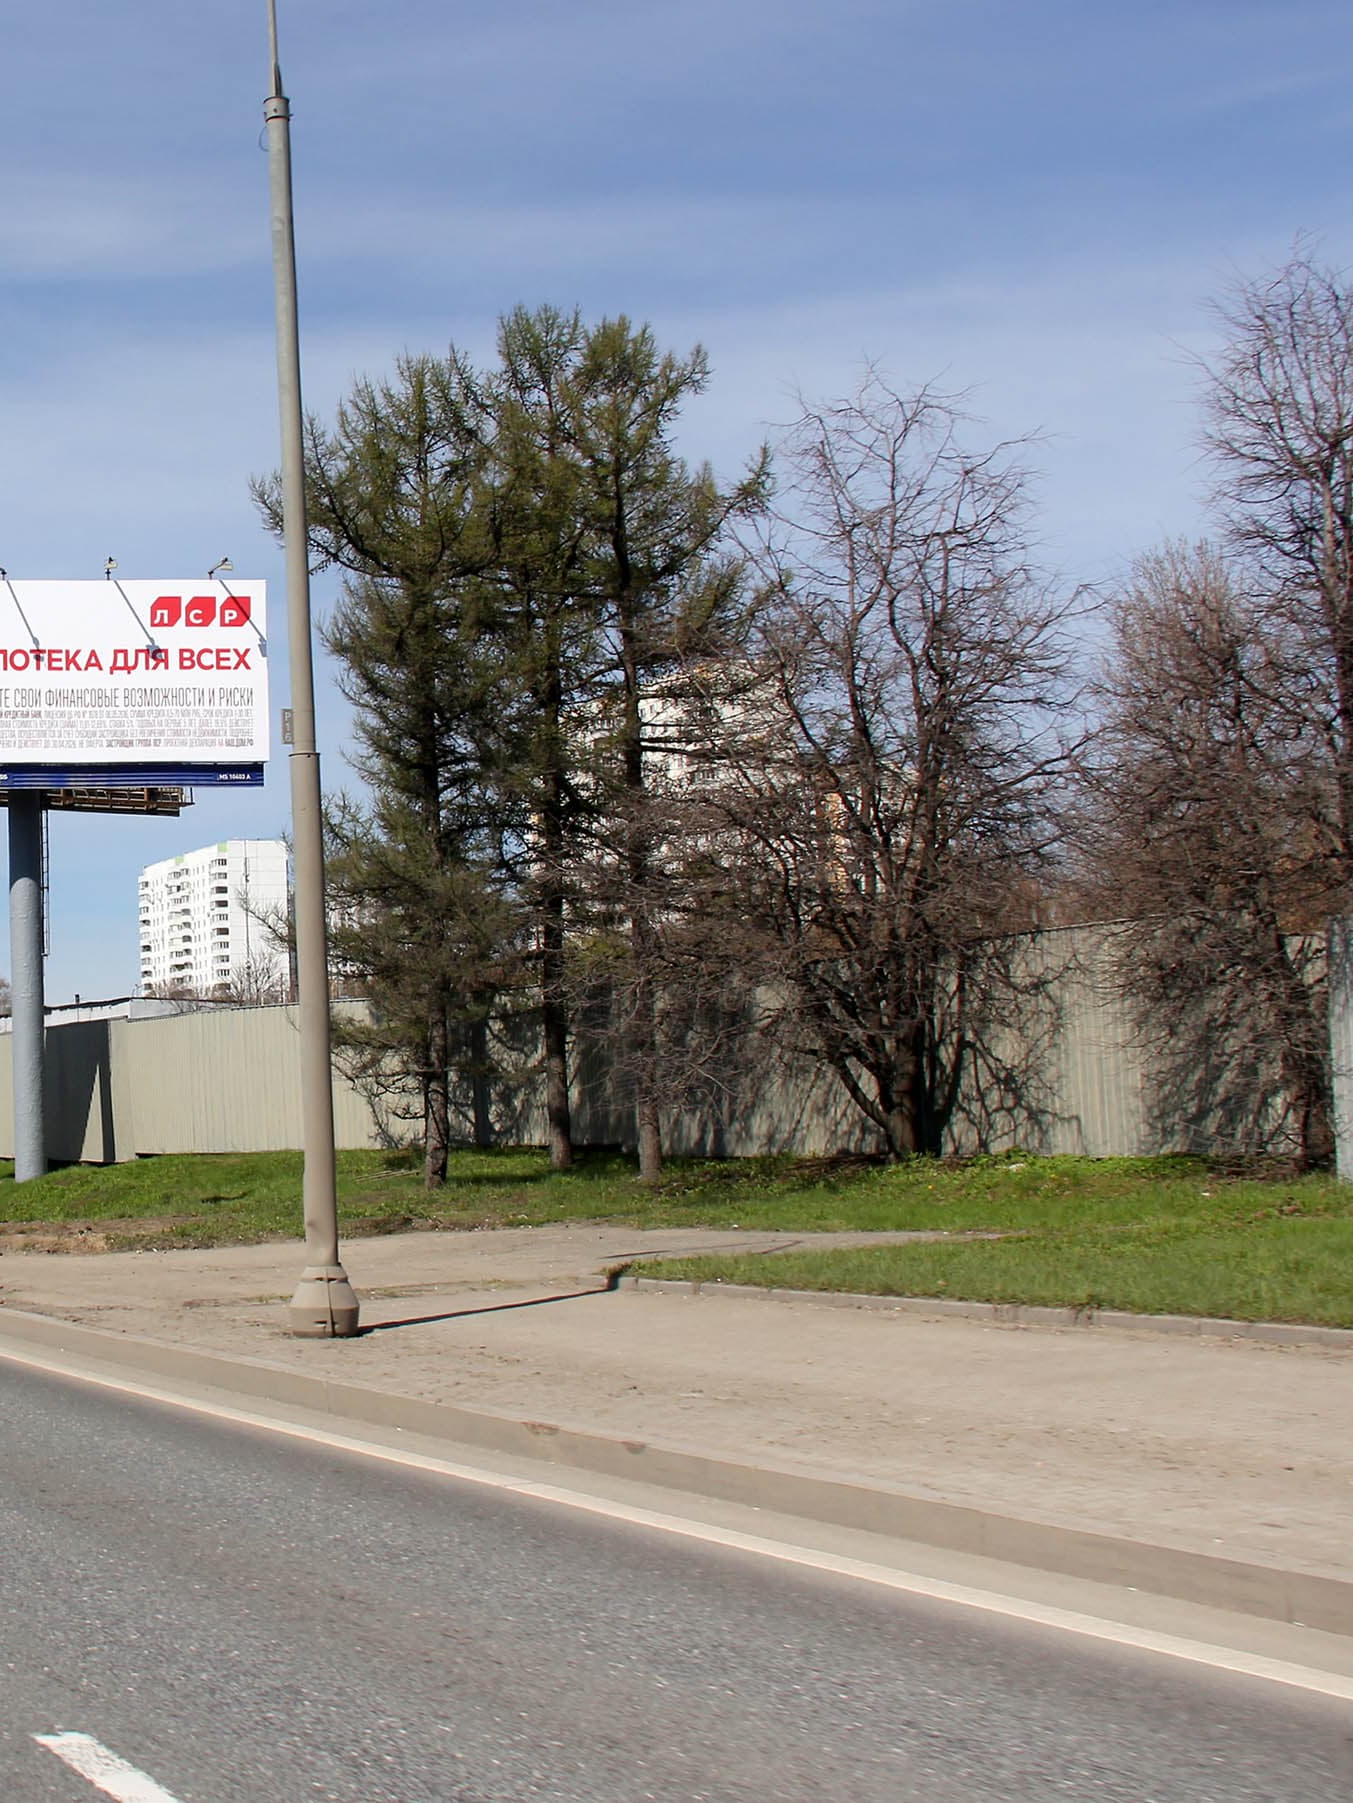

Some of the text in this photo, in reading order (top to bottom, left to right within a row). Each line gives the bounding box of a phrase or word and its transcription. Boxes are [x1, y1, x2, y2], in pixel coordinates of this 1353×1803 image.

[110, 648, 169, 674] ДЛЯ
[179, 648, 250, 670] ВСЕХ
[14, 688, 42, 708] СВОИ
[45, 688, 120, 709] ФИНАНСОВЫЕ
[124, 687, 205, 707] ВОЗМОЖНОСТИ
[209, 687, 216, 707] И
[219, 687, 253, 706] РИСКИ
